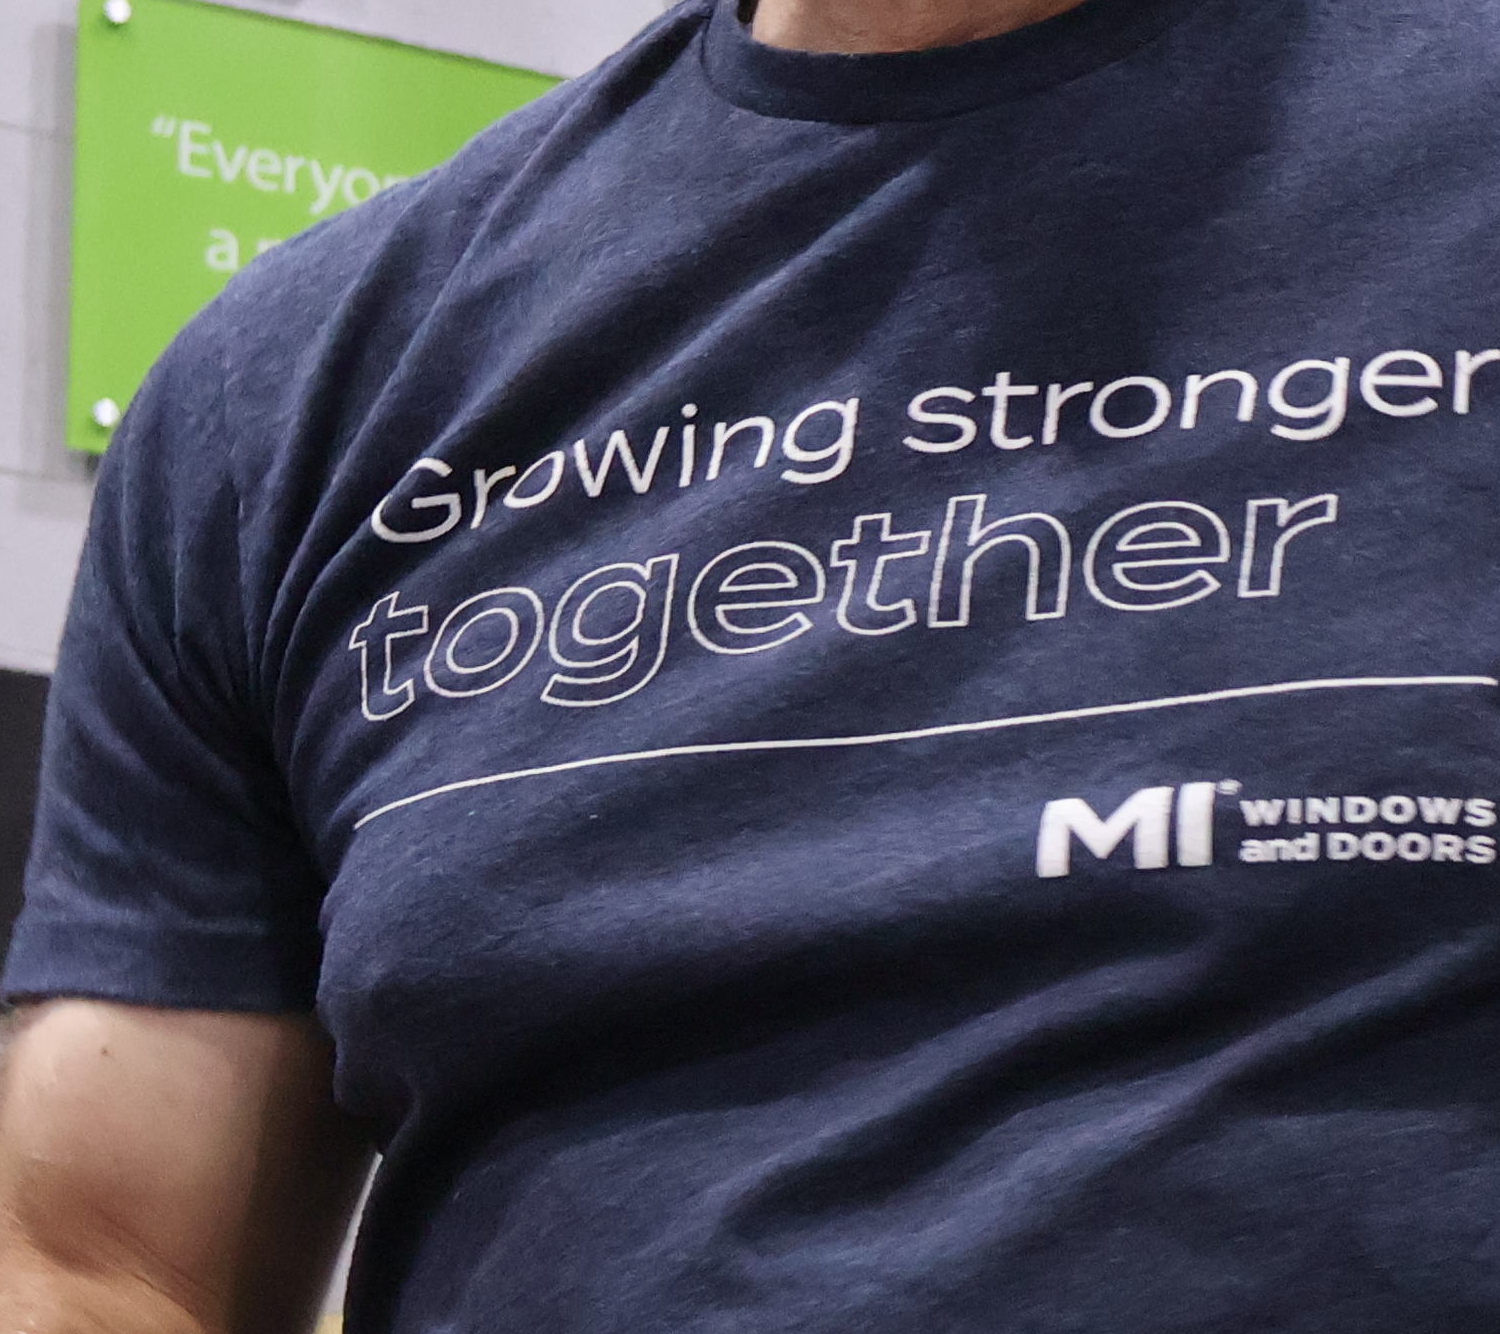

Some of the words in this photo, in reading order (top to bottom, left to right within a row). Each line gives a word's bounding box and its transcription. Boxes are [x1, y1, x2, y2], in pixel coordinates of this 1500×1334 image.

[204, 227, 241, 272] a
[370, 397, 861, 543] Growing
[348, 494, 1338, 723] together
[1238, 795, 1498, 827] WINDOWS
[1238, 832, 1320, 864] and
[1326, 832, 1498, 864] DOORS
